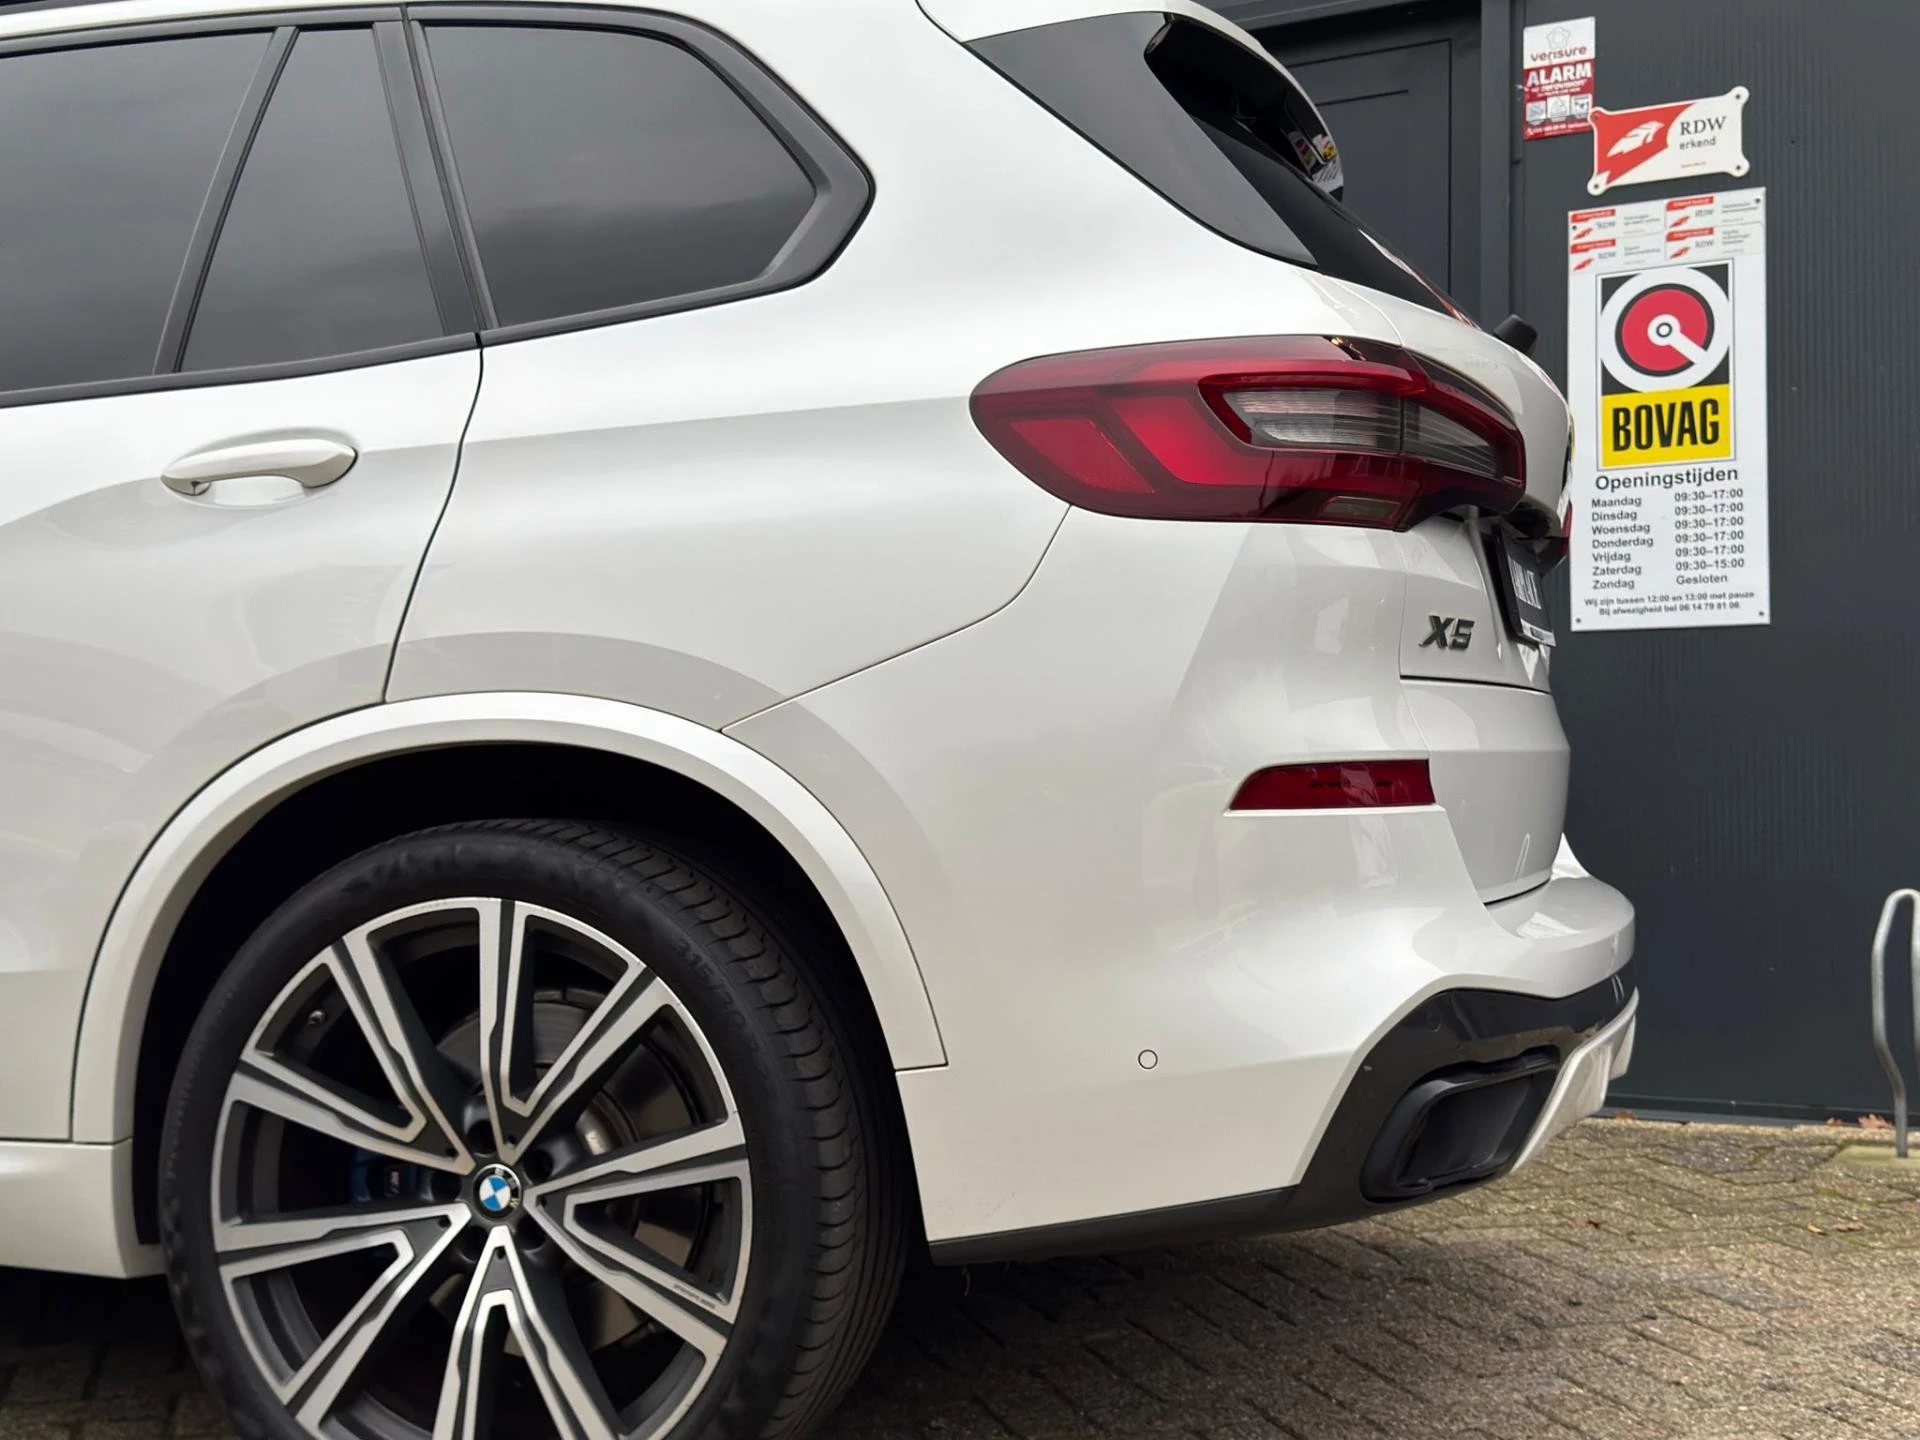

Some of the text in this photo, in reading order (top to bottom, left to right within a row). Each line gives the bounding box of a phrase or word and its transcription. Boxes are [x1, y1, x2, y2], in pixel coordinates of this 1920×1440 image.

[1531, 47, 1588, 62] verisure
[1526, 61, 1592, 88] ALARM
[1680, 115, 1727, 136] RDW
[1679, 135, 1716, 150] erkend
[1612, 398, 1720, 452] BOVAG
[1595, 467, 1738, 492] Openingstijden
[1591, 495, 1642, 509] Maandag
[1591, 510, 1638, 523] Dinsdag
[1591, 523, 1651, 536] Woensdag
[1592, 536, 1654, 550] Donderdag
[1592, 551, 1632, 564] Vrijdag
[1592, 564, 1642, 577] Zaterdag
[1592, 573, 1729, 591] Zondag Gesloten
[1584, 598, 1598, 607] Wij
[1647, 594, 1670, 603] 12:00
[1418, 614, 1475, 651] X5
